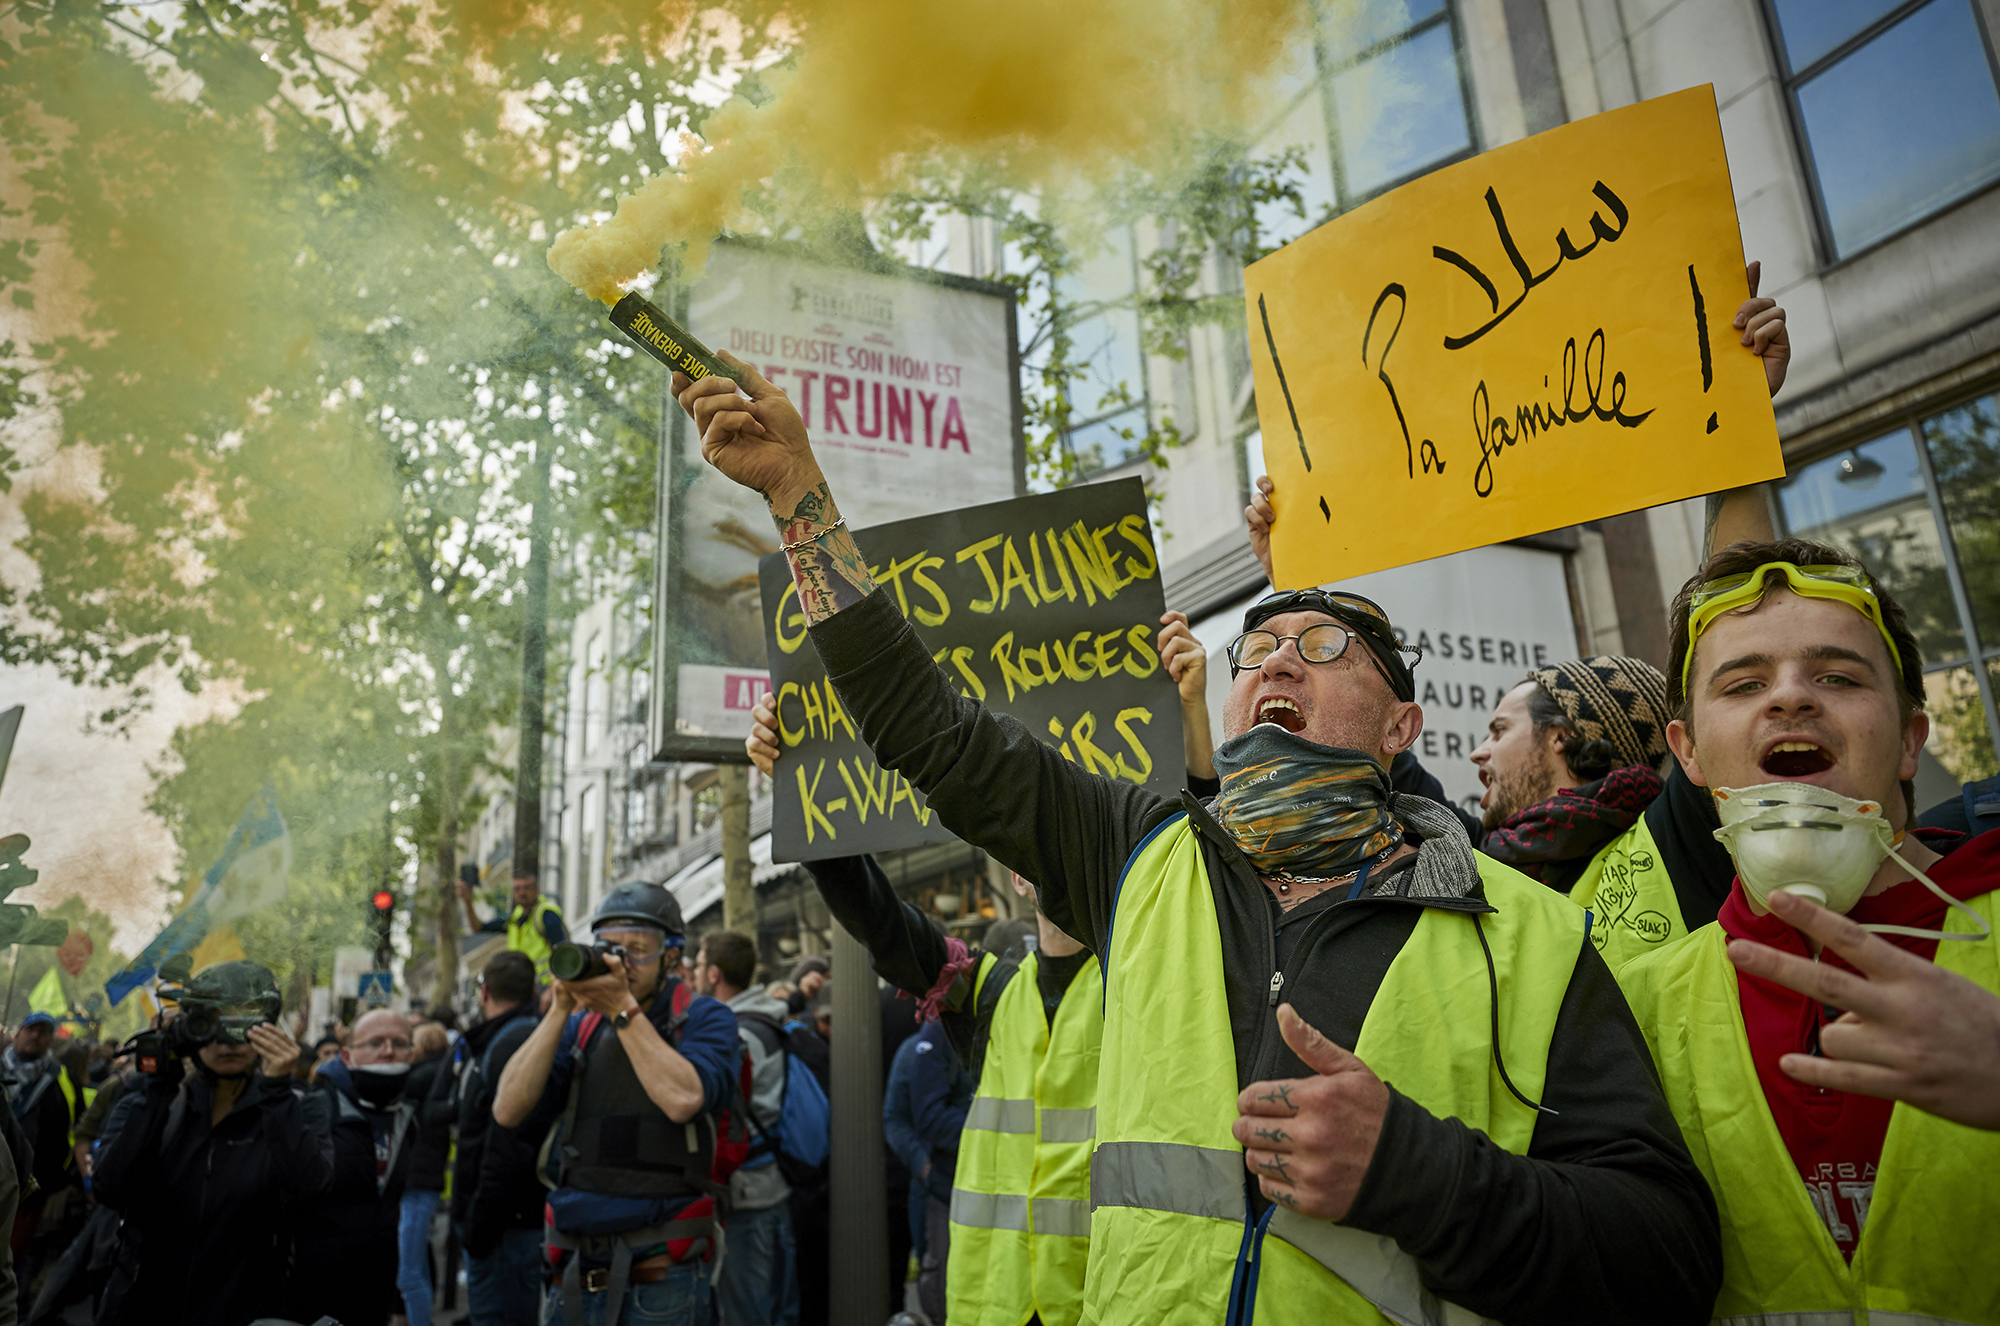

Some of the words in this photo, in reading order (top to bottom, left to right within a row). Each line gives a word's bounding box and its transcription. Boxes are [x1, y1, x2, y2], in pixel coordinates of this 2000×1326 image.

[629, 310, 683, 360] GRENADE
[679, 353, 716, 380] OKE
[730, 327, 774, 356] DIEU
[781, 335, 843, 370] EXISTE,
[847, 346, 883, 374] SON
[889, 355, 930, 382] NOM
[935, 363, 963, 388] EST
[1472, 327, 1657, 498] famille
[775, 549, 950, 654] GTS
[955, 513, 1157, 614] JAUNES
[990, 624, 1159, 704] ROUGES
